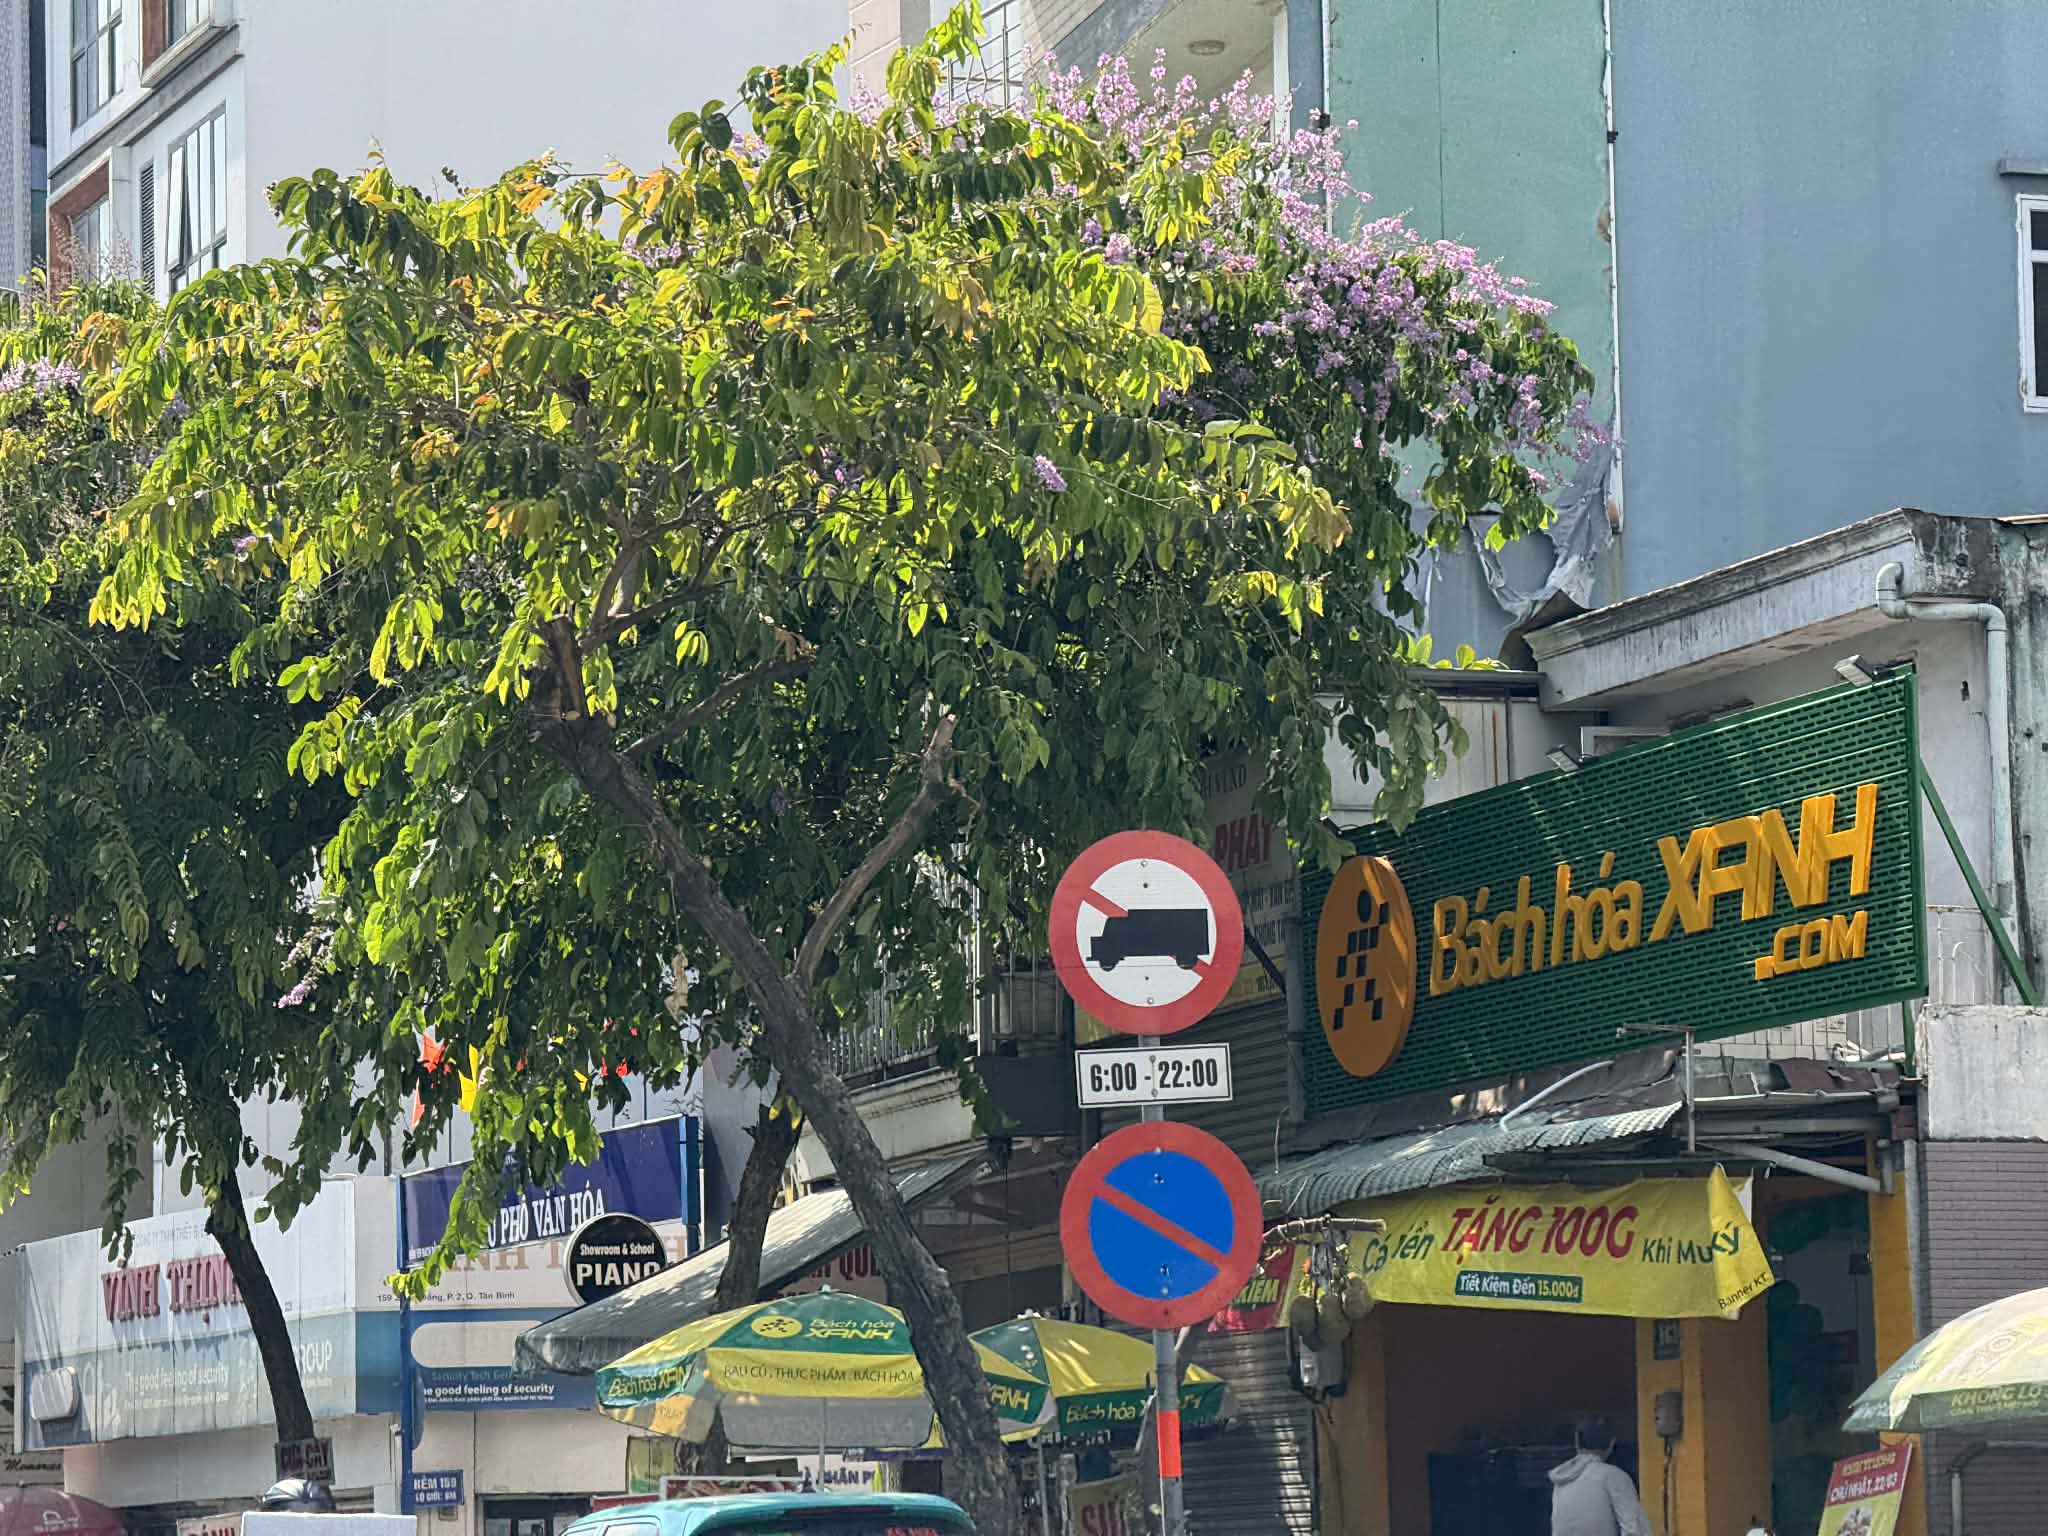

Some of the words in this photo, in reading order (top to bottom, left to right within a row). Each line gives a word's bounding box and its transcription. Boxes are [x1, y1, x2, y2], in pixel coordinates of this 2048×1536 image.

[1429, 875, 1545, 995] Bách
[1551, 852, 1642, 967] hóa
[1648, 783, 1878, 942] XANH
[1754, 910, 1868, 981] .COM
[1090, 1062, 1137, 1092] 6:00
[1158, 1058, 1218, 1089] 22:00
[532, 1189, 565, 1238] VĂN
[1442, 1195, 1544, 1264] TẶNG
[1542, 1204, 1639, 1258] 100G
[580, 1243, 620, 1256] Showroom
[622, 1243, 628, 1255] &
[629, 1242, 655, 1255] School
[1363, 1233, 1392, 1273] Cá
[1642, 1238, 1672, 1264] Khi
[576, 1262, 660, 1286] PIANO
[1460, 1273, 1480, 1291] Tiết
[1481, 1275, 1510, 1296] Kiệm
[1512, 1276, 1536, 1295] Đến
[378, 1294, 392, 1302] 159
[1718, 1284, 1754, 1310] Banner
[804, 1328, 895, 1340] XANH
[294, 1340, 333, 1374] ROUP
[435, 1384, 461, 1397] good
[464, 1384, 499, 1397] feeling
[501, 1384, 513, 1394] of
[514, 1383, 555, 1395] security
[659, 1366, 688, 1389] XAN
[1108, 1400, 1136, 1419] hóa
